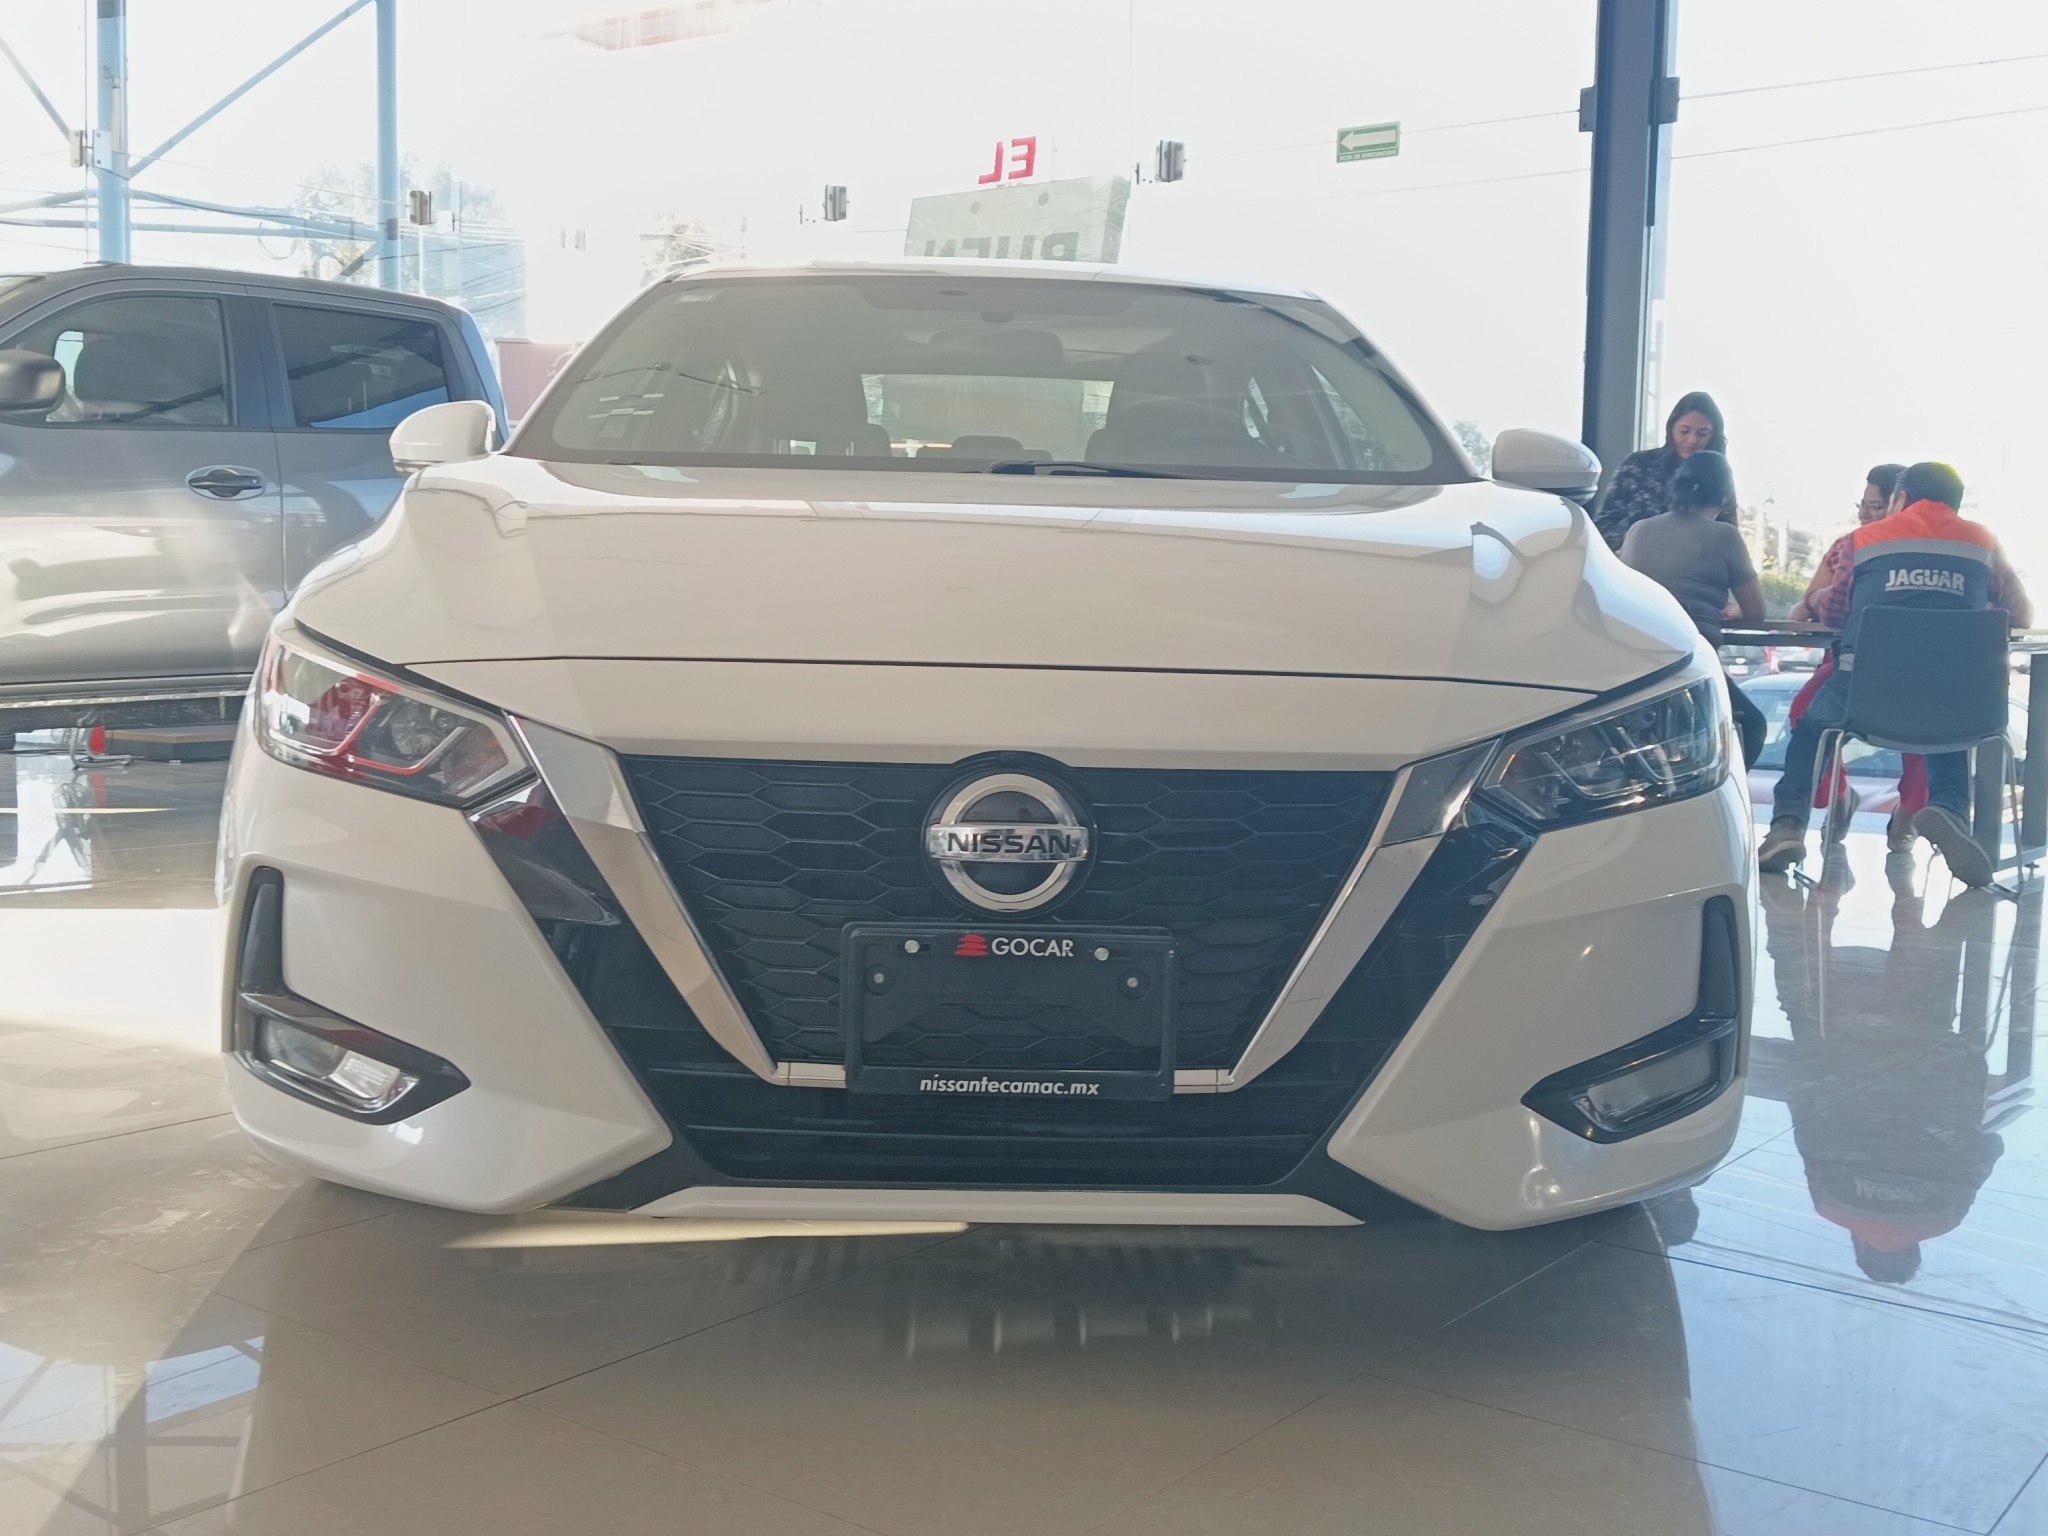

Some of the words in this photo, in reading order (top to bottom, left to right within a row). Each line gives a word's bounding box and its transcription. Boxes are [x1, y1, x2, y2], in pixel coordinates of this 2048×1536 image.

[1886, 568, 1965, 591] JAGUAR
[947, 833, 1071, 855] NISSAN
[991, 937, 1074, 957] GOCAR
[919, 1074, 1099, 1096] nissantecamac.mx
